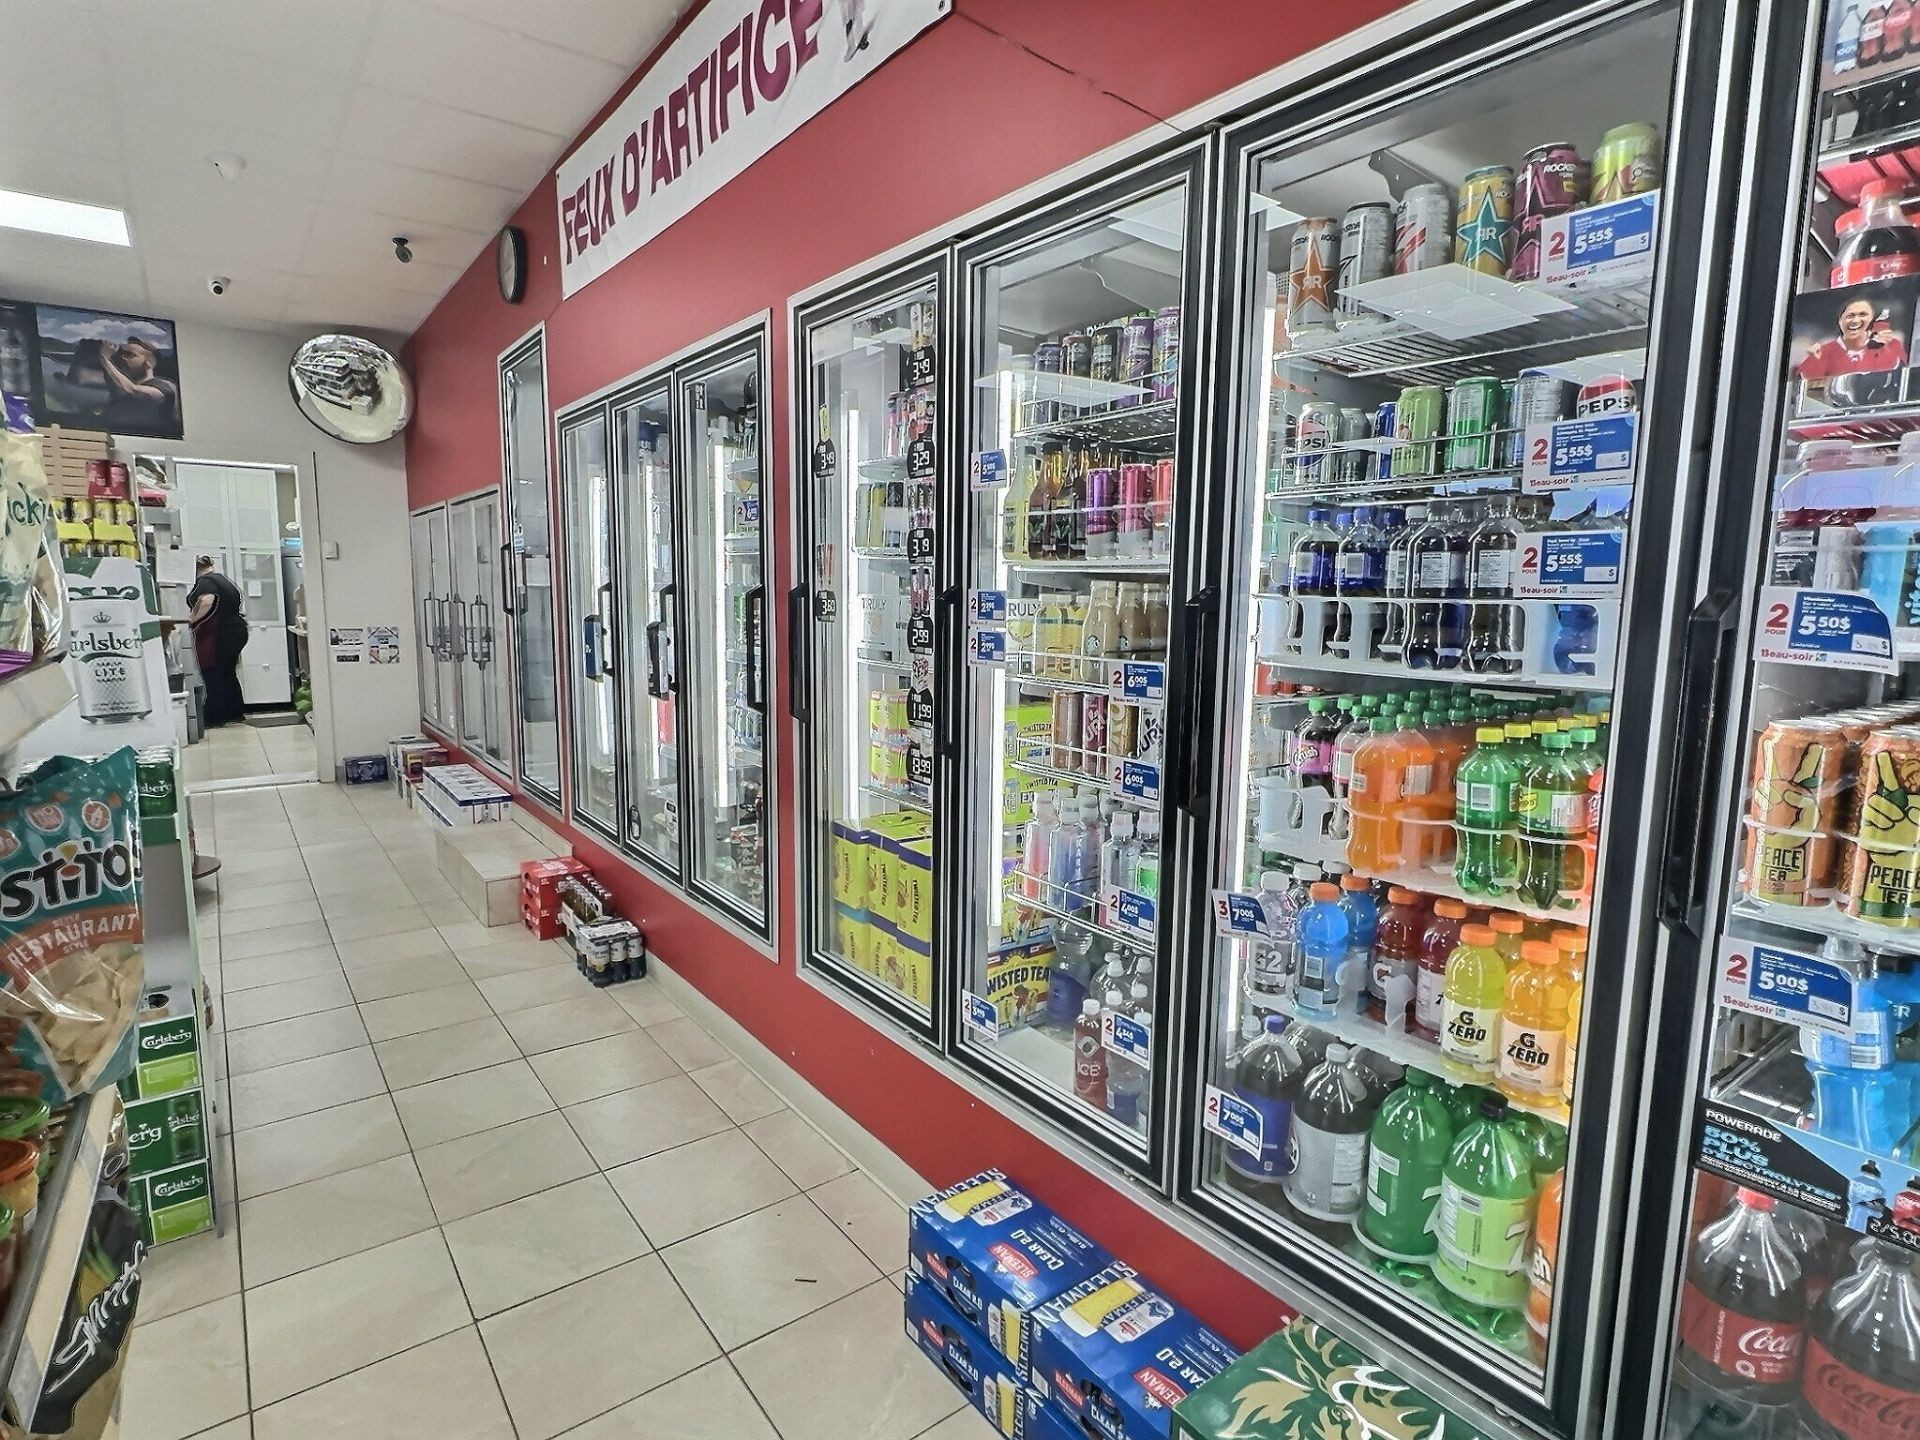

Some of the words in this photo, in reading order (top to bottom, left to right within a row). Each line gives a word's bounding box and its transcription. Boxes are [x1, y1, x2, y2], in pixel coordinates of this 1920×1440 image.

[562, 157, 617, 265] FEUX
[621, 0, 822, 217] D'ARTIFICE
[1549, 231, 1565, 256] 2
[1533, 438, 1548, 461] 2
[974, 460, 980, 474] 2
[1529, 476, 1569, 488] Beau-soir
[1522, 546, 1538, 569] 2
[1520, 585, 1558, 595] Beau-soir
[970, 597, 977, 610] 2
[1765, 603, 1790, 629] 2
[970, 638, 977, 650] 2
[1760, 648, 1815, 661] Beau-soir
[95, 668, 126, 677] LITE
[1113, 670, 1122, 685] 2
[1114, 766, 1122, 780] 2
[1110, 894, 1118, 909] 2
[1218, 900, 1229, 916] 3
[7, 913, 138, 970] RESTAURANT
[1031, 966, 1052, 983] TEA
[1726, 953, 1748, 980] 2
[1722, 995, 1774, 1015] Beau-soir
[1105, 1017, 1113, 1032] 2
[1460, 1011, 1474, 1026] G
[141, 1029, 192, 1050] Carlsberg
[1447, 1021, 1487, 1042] ZERO
[1520, 1032, 1536, 1049] G
[1506, 1044, 1550, 1066] ZERO
[1208, 1096, 1218, 1114] 2
[1705, 1108, 1783, 1143] POWERADE
[1704, 1125, 1761, 1153] 50%
[1703, 1137, 1769, 1167] PLUS
[154, 1176, 204, 1198] Carlsberg
[910, 1167, 1008, 1217] SLEEMAN
[1010, 1228, 1034, 1247] 2.0
[993, 1243, 1036, 1278] SLEEMAN
[1028, 1239, 1065, 1271] CLEAR
[1031, 1260, 1138, 1328] SLEEMAN
[1155, 1347, 1183, 1371] 2.0
